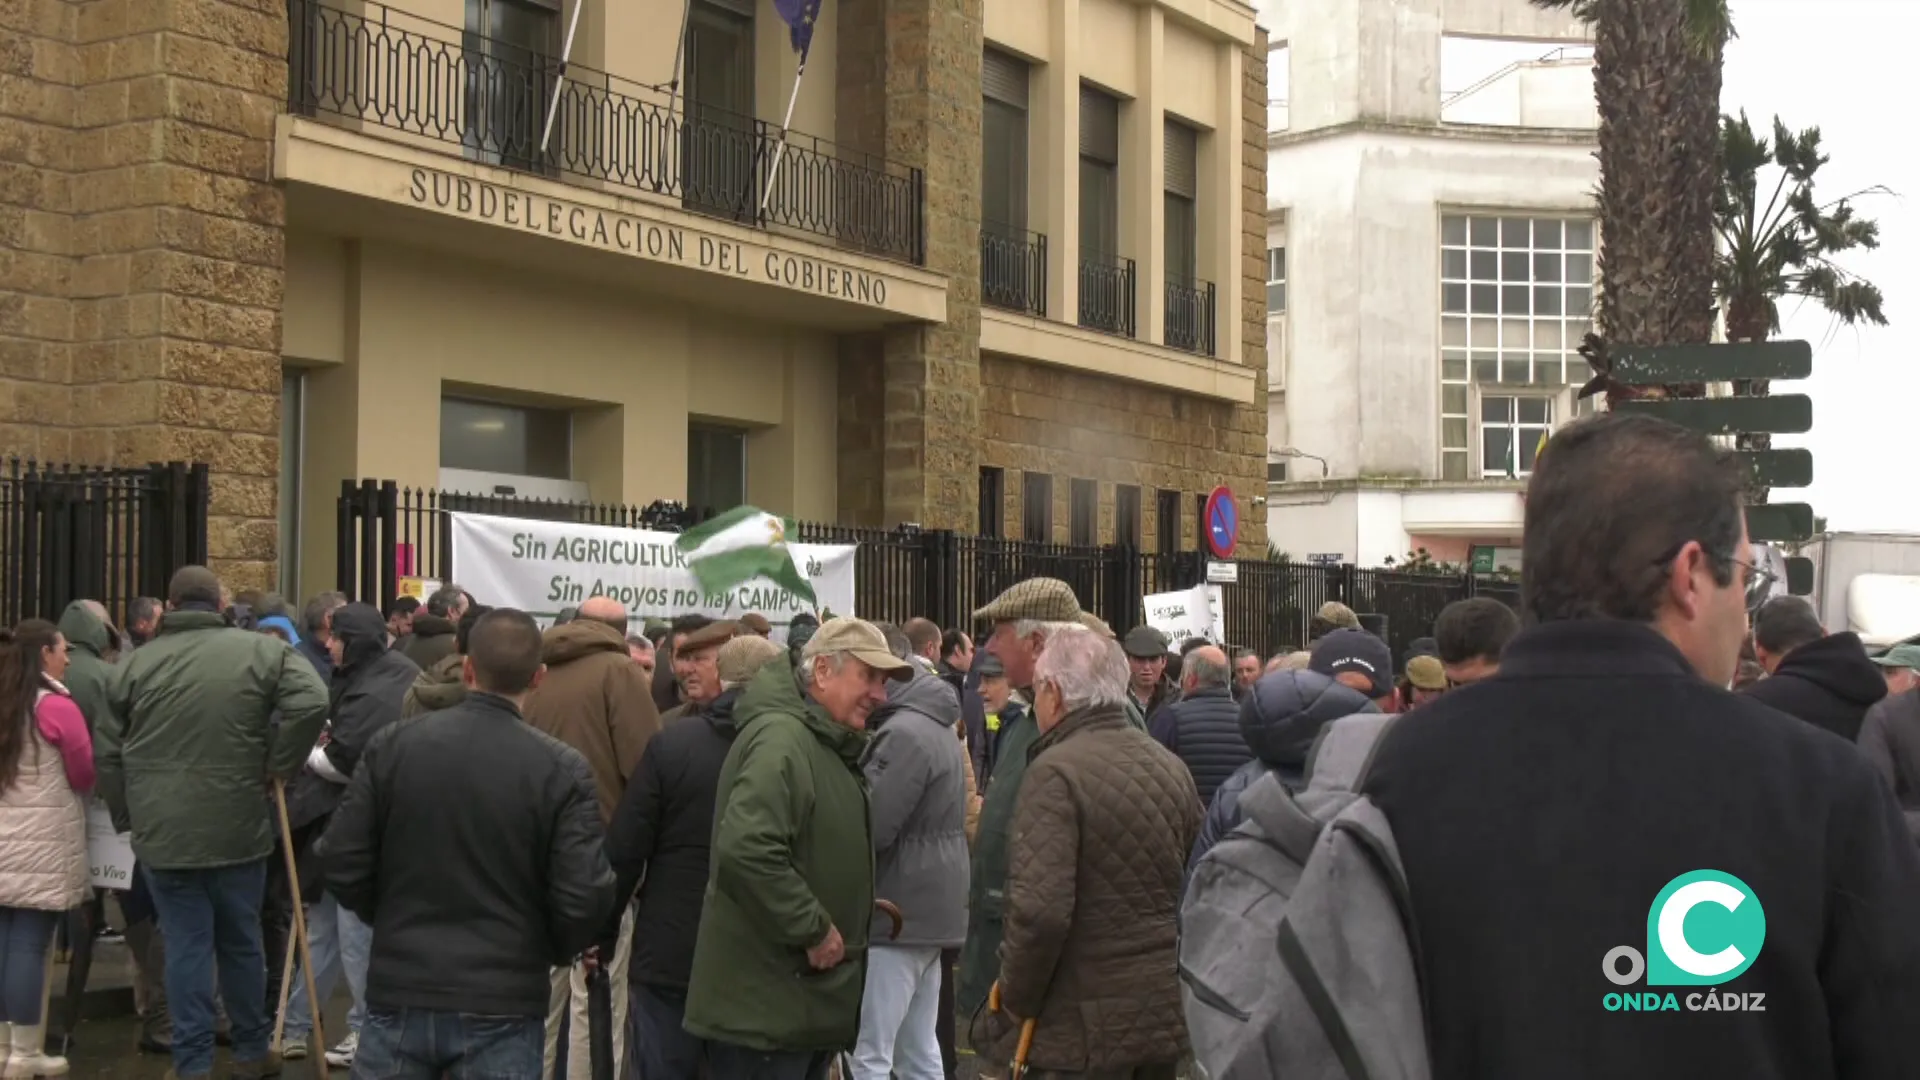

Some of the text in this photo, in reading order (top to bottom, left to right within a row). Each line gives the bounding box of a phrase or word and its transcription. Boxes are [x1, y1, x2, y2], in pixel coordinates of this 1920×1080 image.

[409, 168, 887, 306] SUBDELEGACION DEL GOBIERNO
[511, 532, 547, 560] Sin
[552, 536, 691, 569] AGRICULTUR
[548, 575, 584, 602] Sin
[673, 588, 699, 608] no
[1172, 628, 1193, 640] UPA
[103, 864, 127, 881] Vivo
